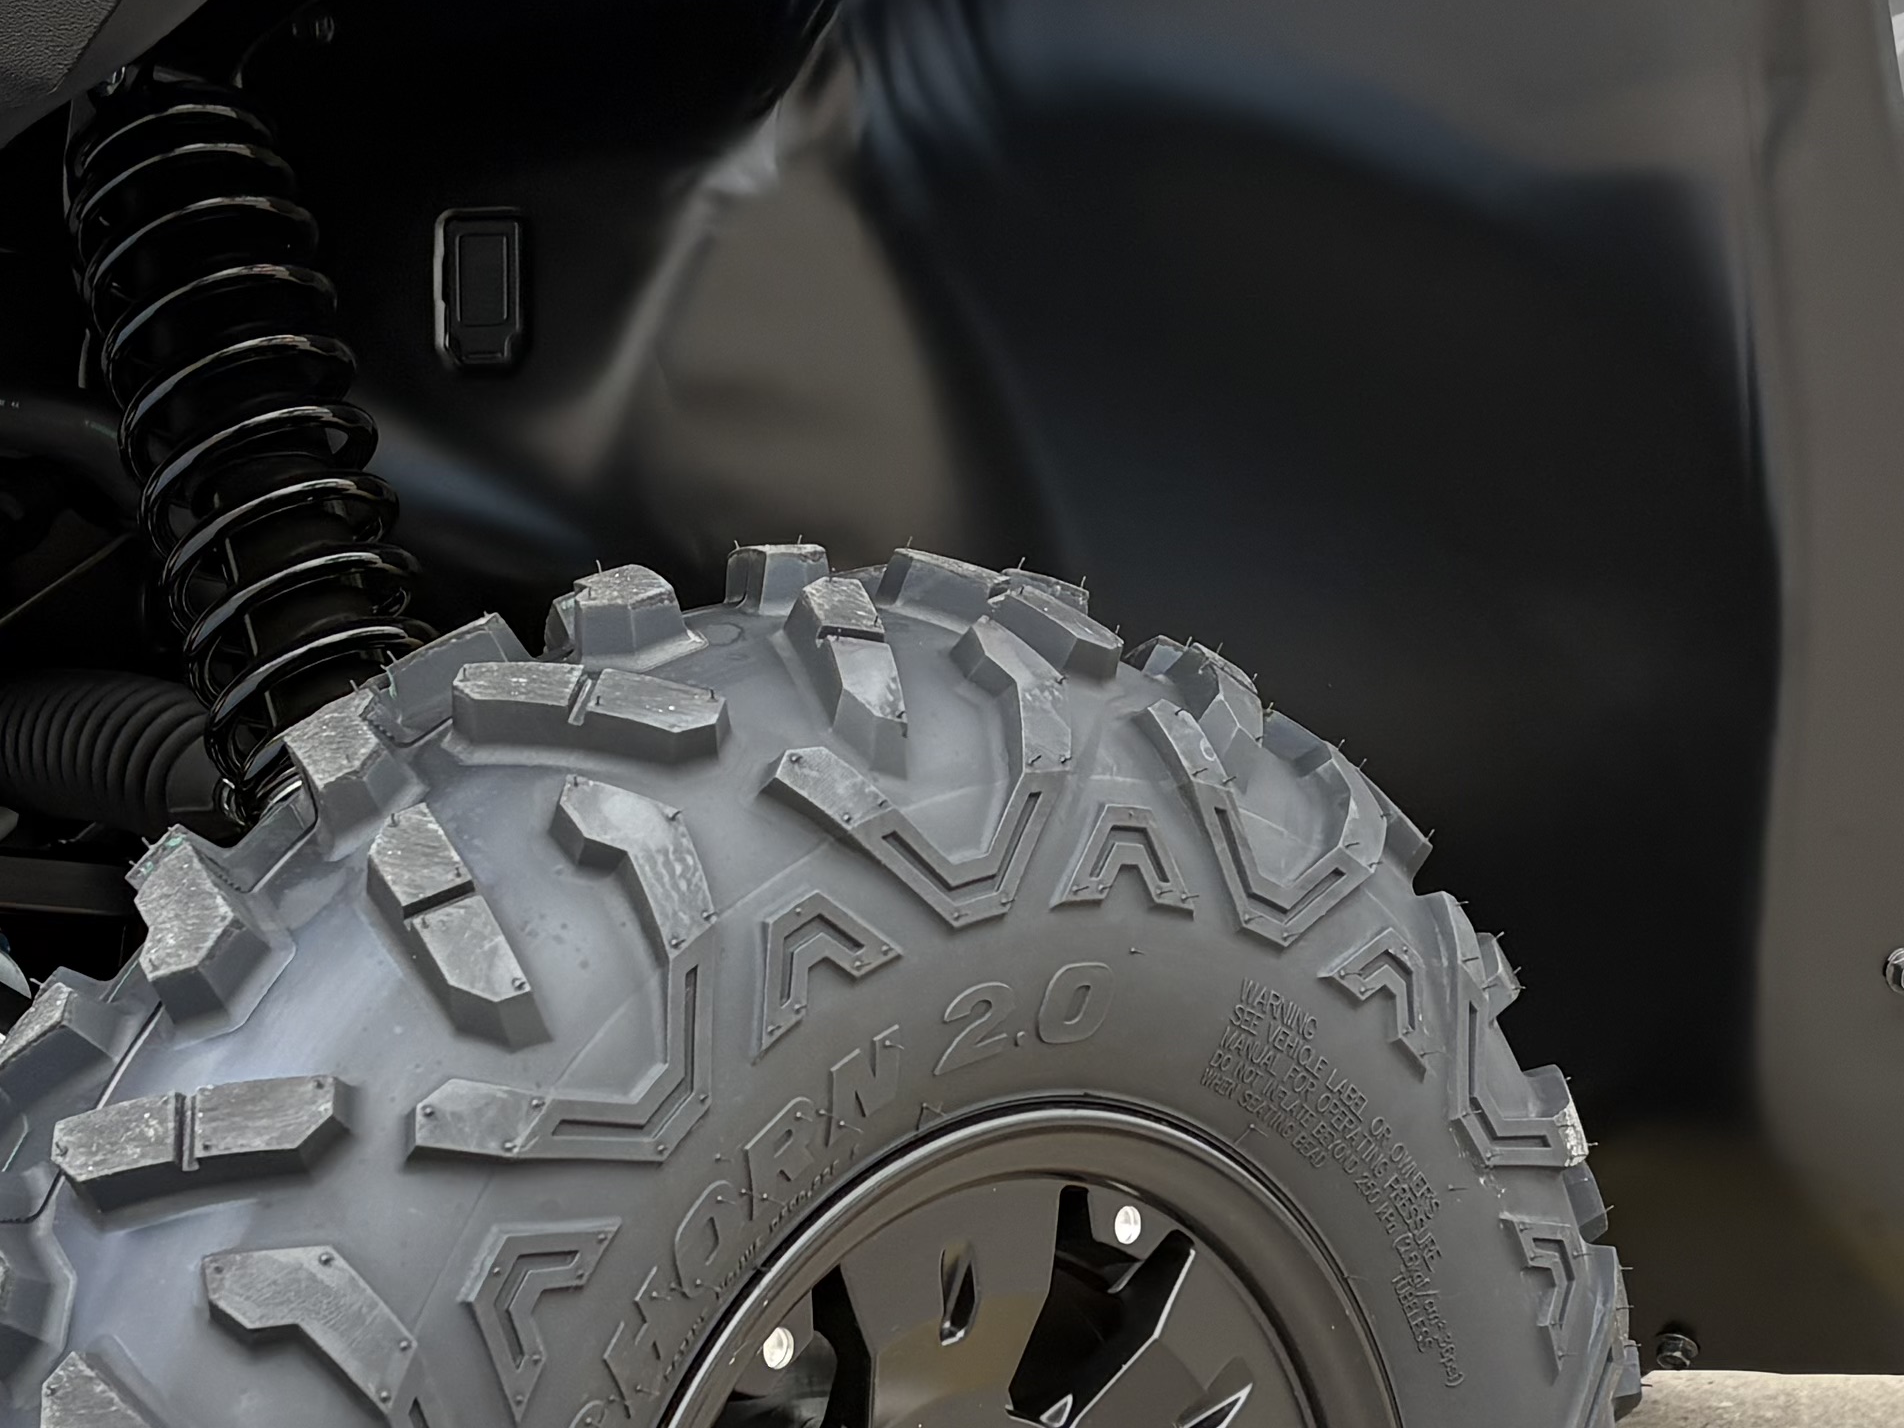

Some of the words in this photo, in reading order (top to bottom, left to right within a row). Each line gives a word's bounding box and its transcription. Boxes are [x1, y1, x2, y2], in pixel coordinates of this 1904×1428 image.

[933, 960, 1115, 1077] 2.0
[1240, 978, 1318, 1041] WARNING
[1199, 1066, 1240, 1101] WHEN
[1237, 1089, 1296, 1140] SEATING
[1289, 1129, 1329, 1170] BEAD
[1209, 1048, 1235, 1073] DO
[1231, 1060, 1265, 1091] NOT
[1260, 1080, 1316, 1130] INFLATE
[1310, 1120, 1362, 1176] BEYOND
[1353, 1169, 1384, 1206] 250
[1228, 1002, 1265, 1038] SEE
[1266, 1025, 1329, 1079] VEHICLE
[1324, 1069, 1369, 1122] LABEL
[1367, 1113, 1396, 1147] OR
[1218, 1024, 1285, 1077] MANUAL
[1280, 1063, 1319, 1100] FOR
[1315, 1092, 1390, 1178] OPERATING
[1382, 1172, 1444, 1272] PRESSURE
[1391, 1265, 1436, 1354] TUBELESS
